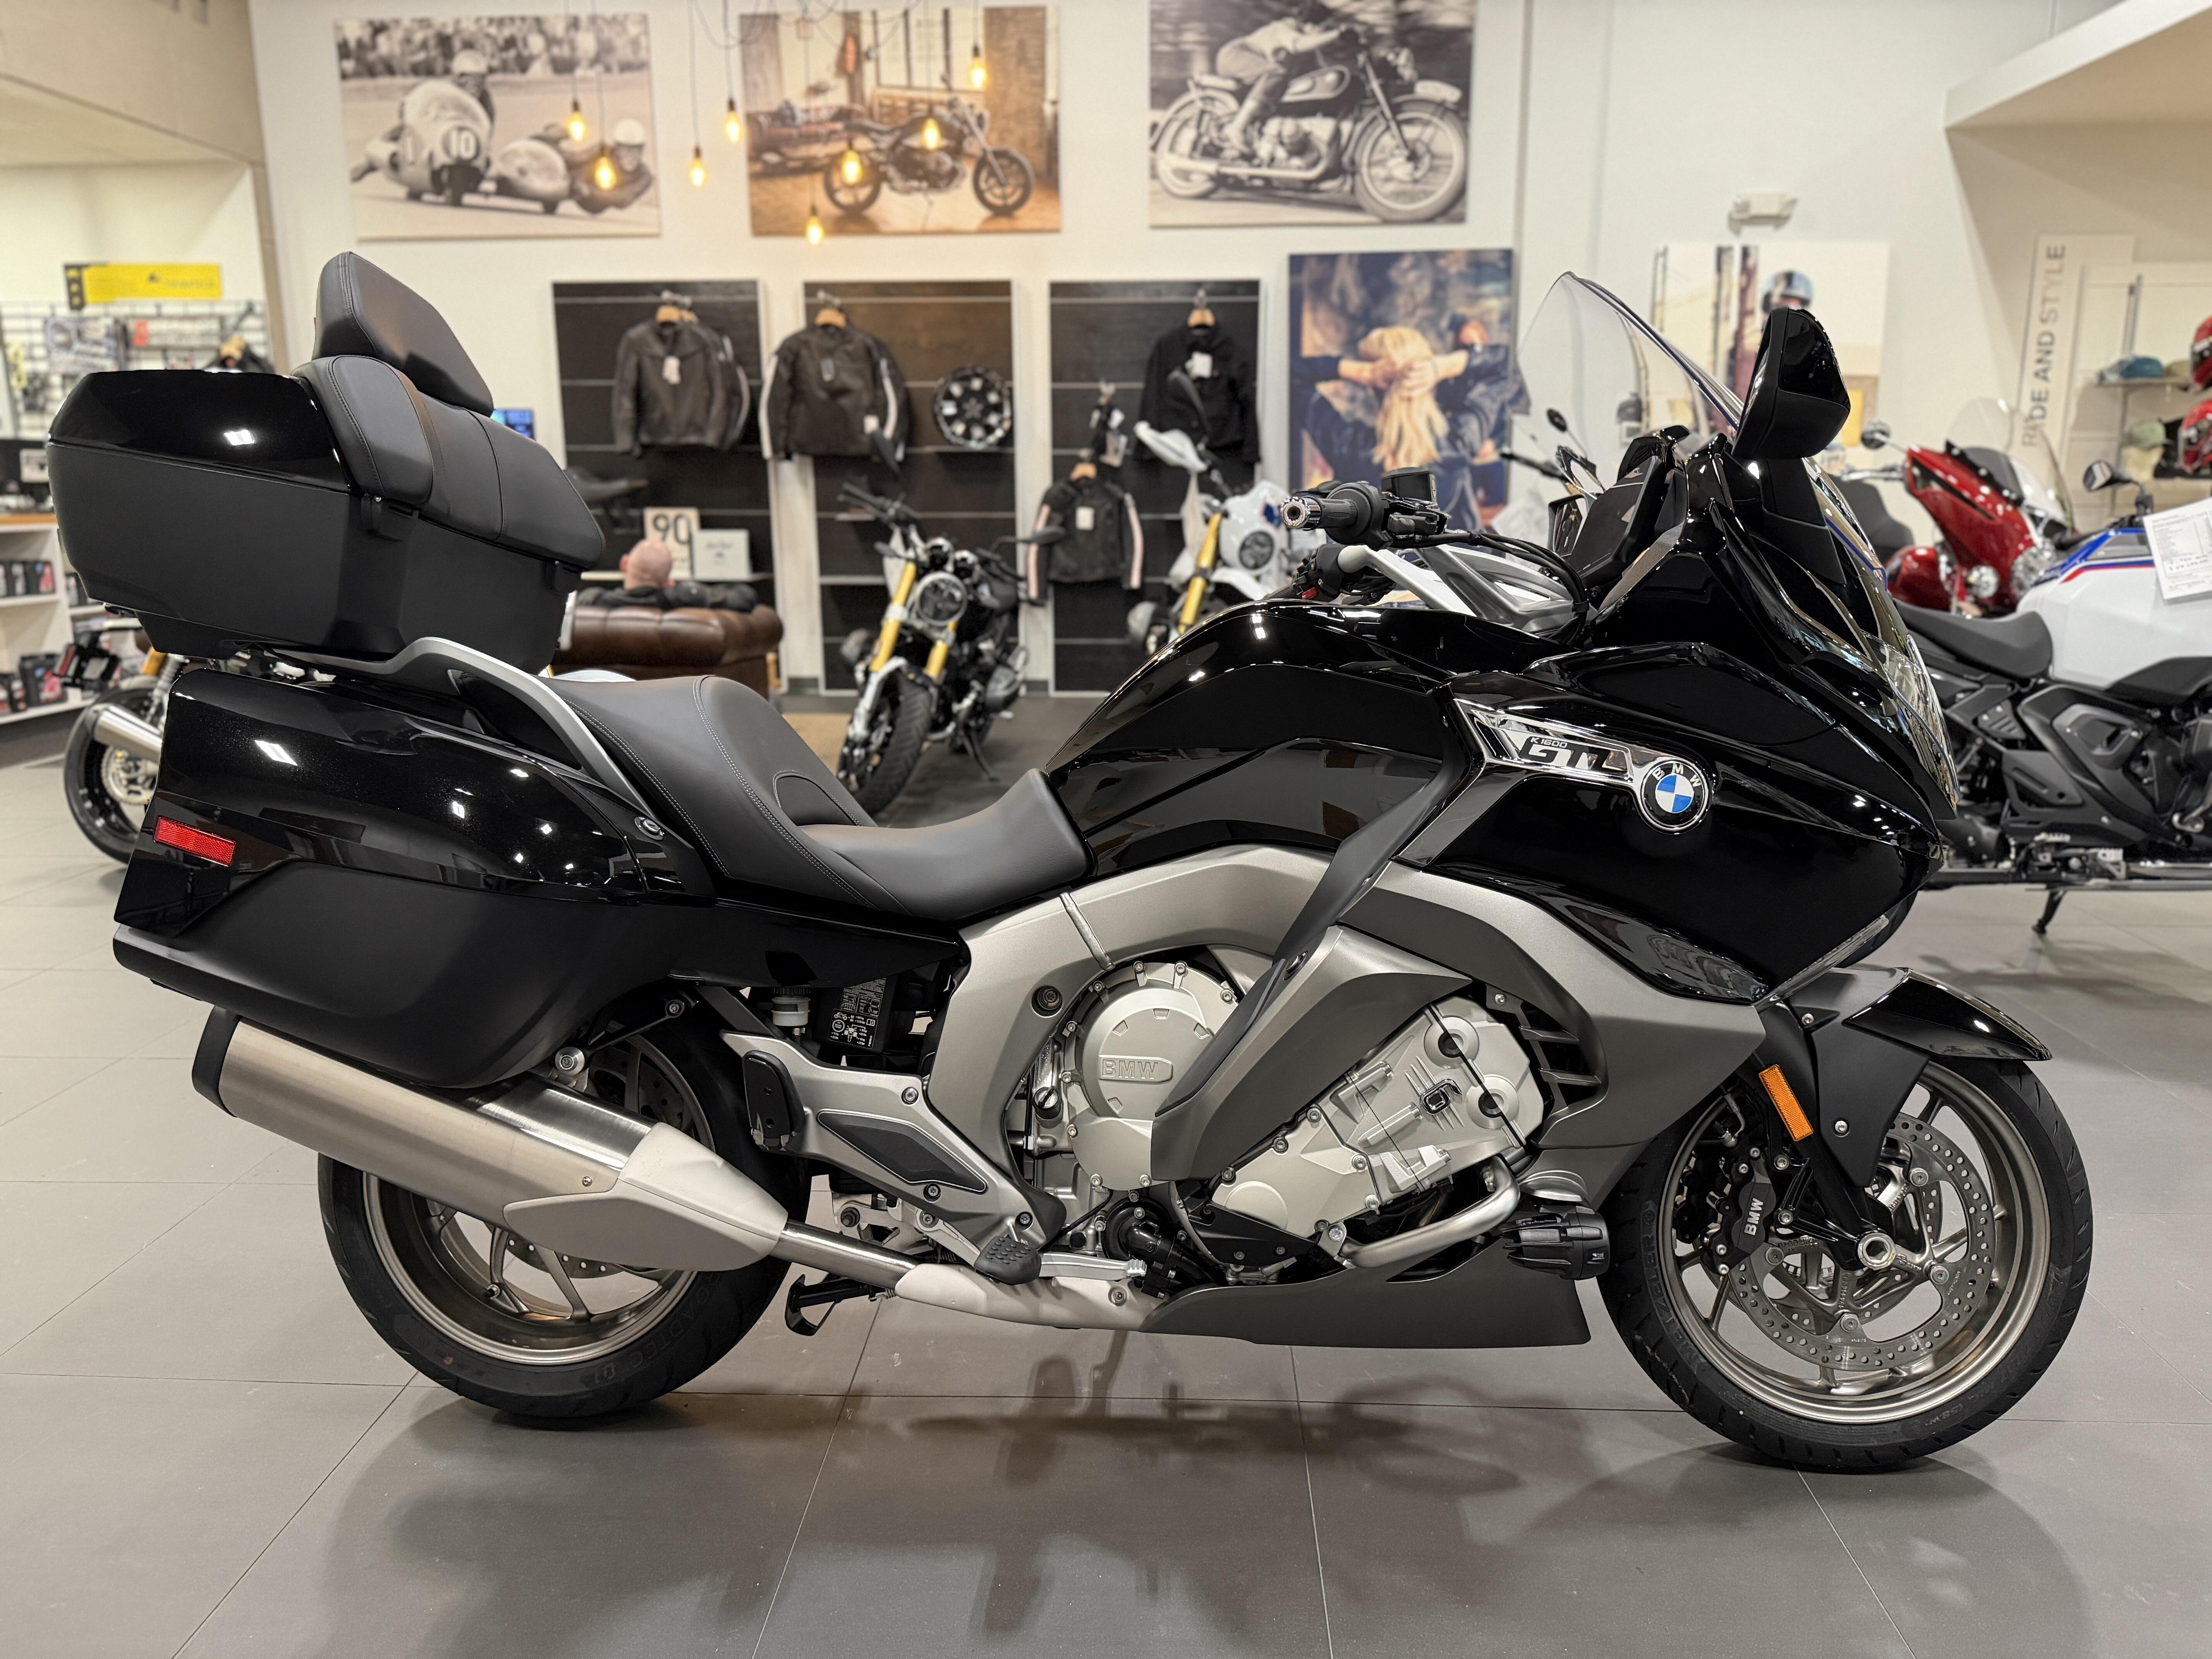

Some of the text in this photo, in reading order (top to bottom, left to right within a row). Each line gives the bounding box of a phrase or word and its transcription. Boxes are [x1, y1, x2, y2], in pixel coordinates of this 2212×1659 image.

[451, 130, 476, 159] 10
[2022, 245, 2066, 448] RIDE AND STYLE
[1519, 736, 1628, 773] GTL
[1541, 738, 1568, 748] 1600
[1652, 763, 1702, 788] BMW
[1102, 1059, 1158, 1079] BMW
[1744, 1198, 1764, 1235] BMW
